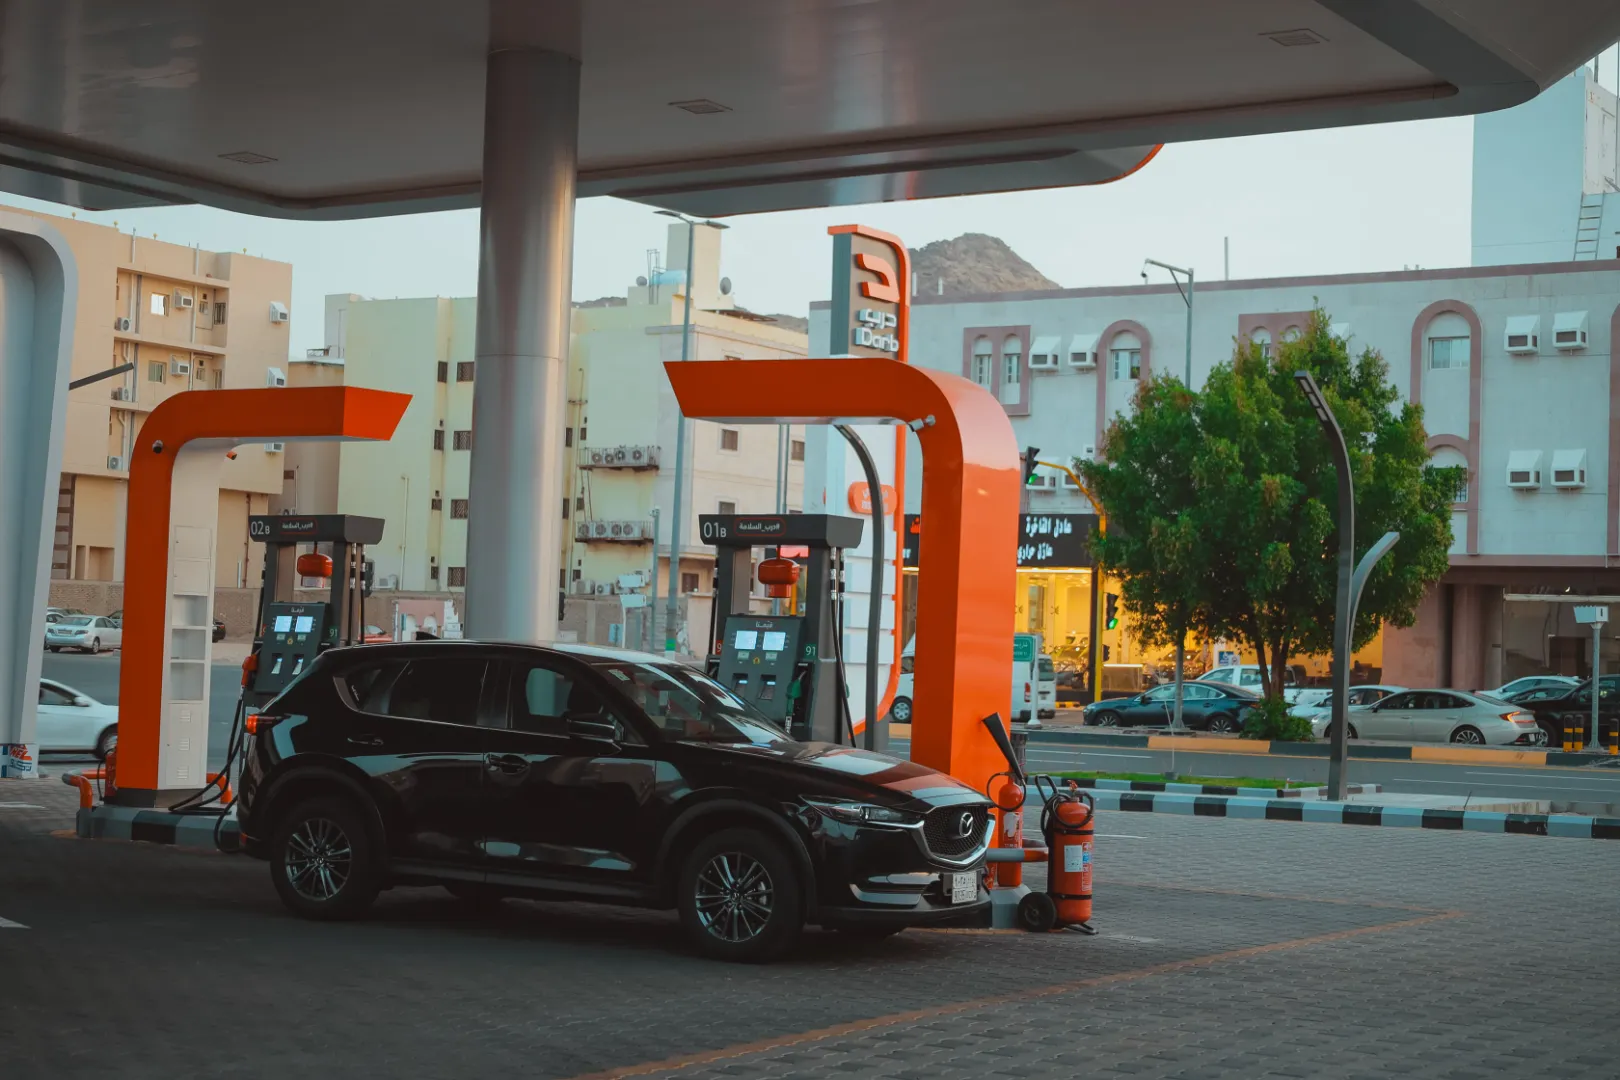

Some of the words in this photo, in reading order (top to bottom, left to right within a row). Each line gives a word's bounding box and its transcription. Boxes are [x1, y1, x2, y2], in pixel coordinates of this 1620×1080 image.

[862, 308, 897, 330] درب
[861, 327, 900, 352] Darb
[329, 628, 338, 637] 91
[805, 645, 816, 656] 91
